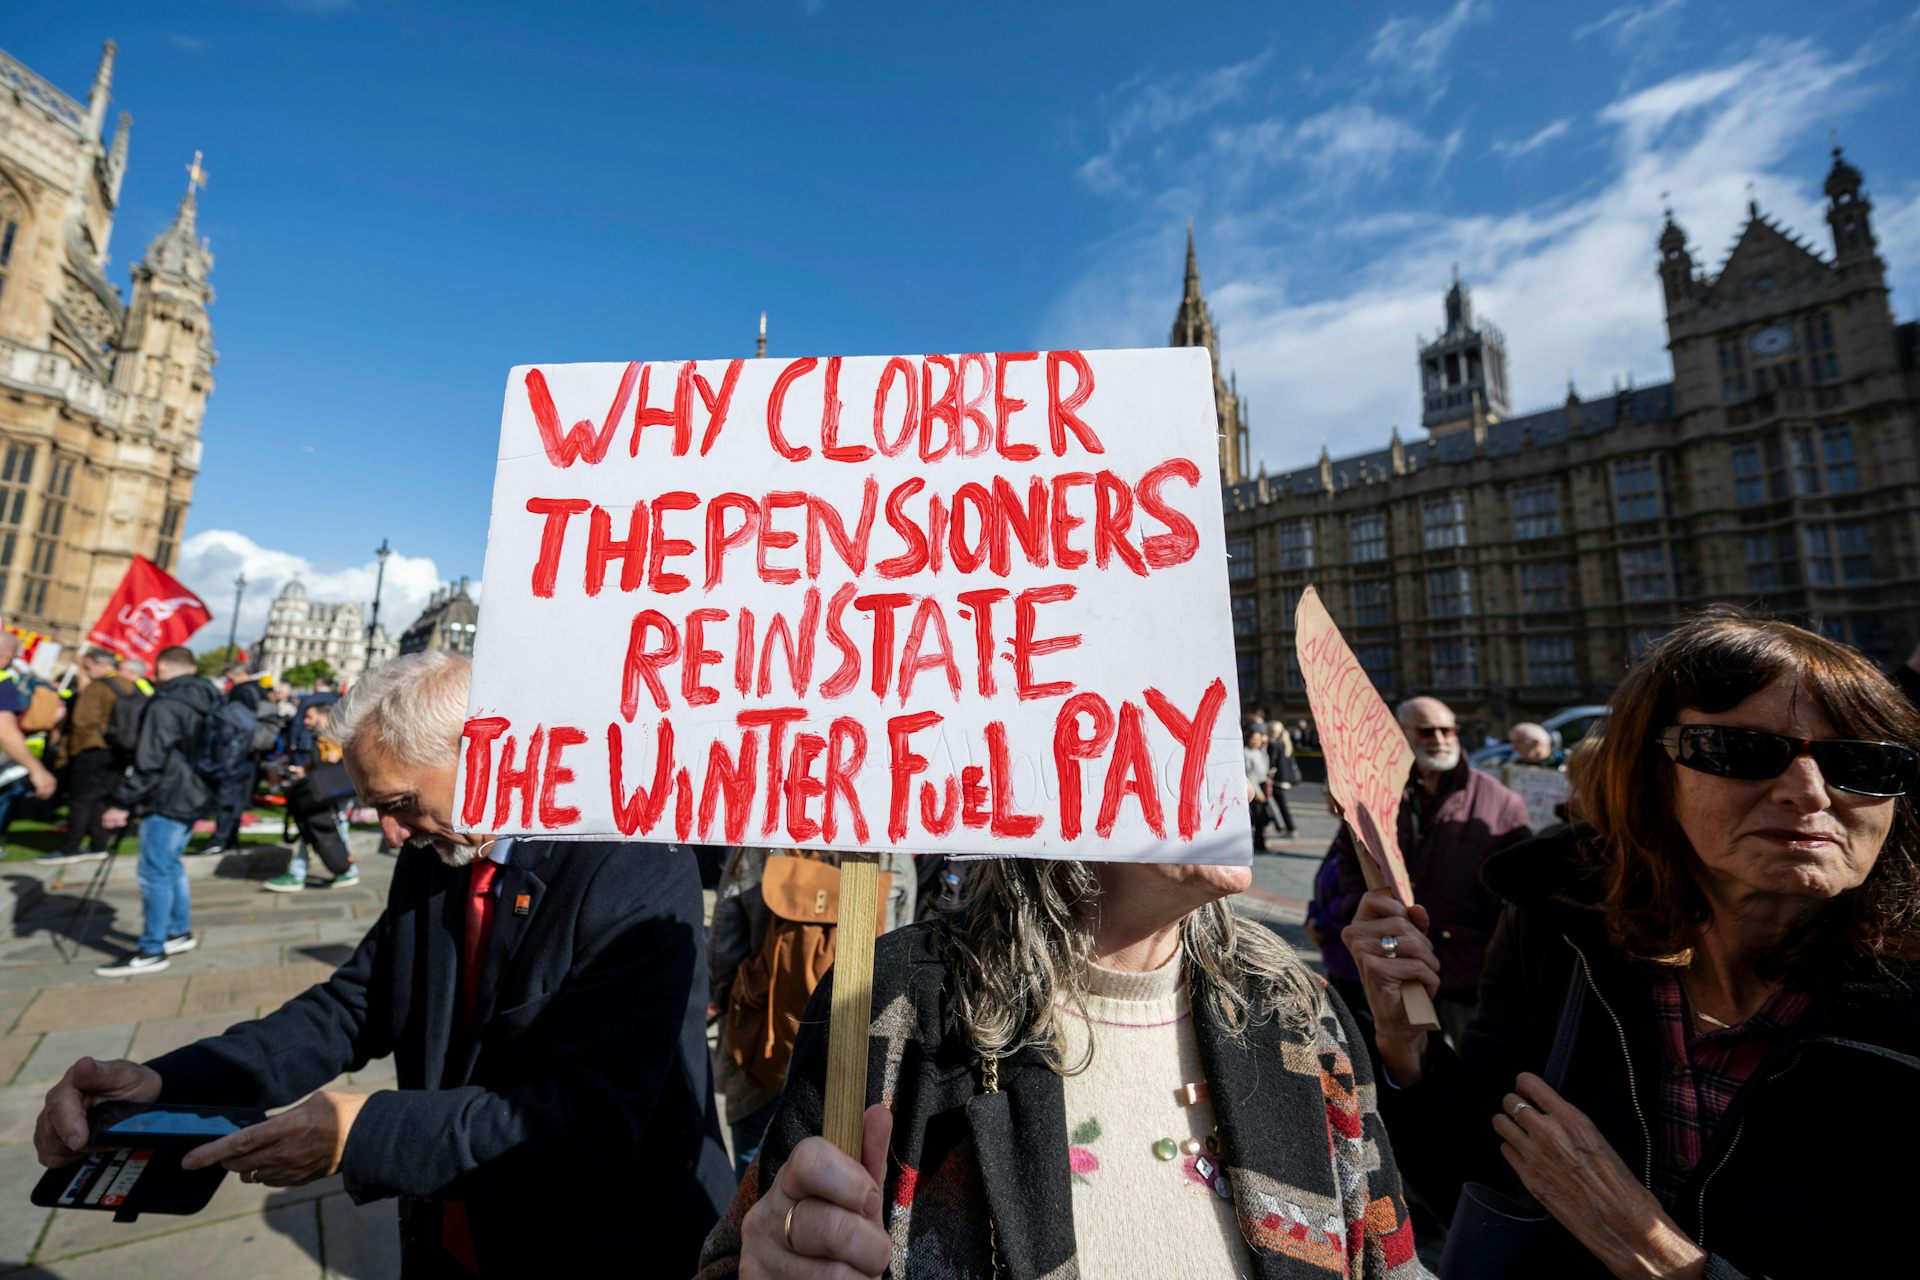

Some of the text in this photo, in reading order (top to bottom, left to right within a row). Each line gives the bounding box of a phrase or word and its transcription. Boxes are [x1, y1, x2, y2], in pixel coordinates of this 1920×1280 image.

[525, 352, 1105, 470] WHY CLOBBER
[620, 582, 1082, 723] REINSTATE
[461, 712, 589, 833] THE
[606, 707, 870, 842] WINTER
[1053, 677, 1227, 842] PAY
